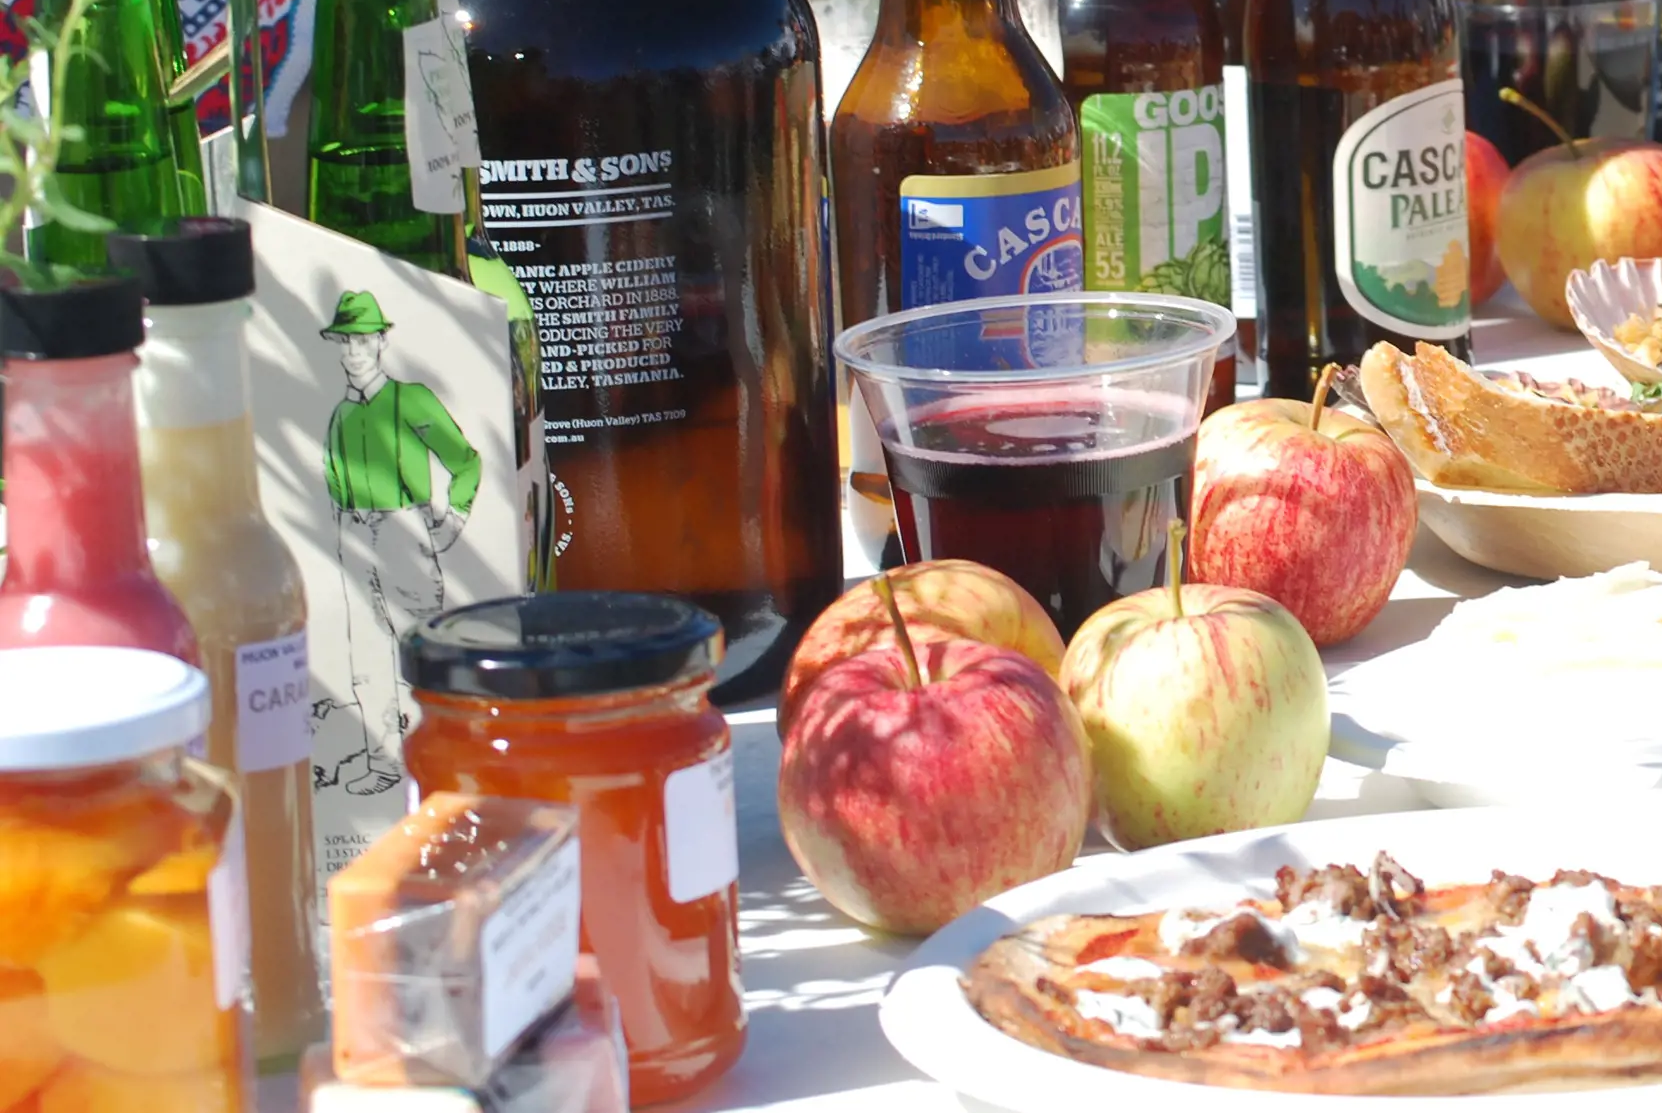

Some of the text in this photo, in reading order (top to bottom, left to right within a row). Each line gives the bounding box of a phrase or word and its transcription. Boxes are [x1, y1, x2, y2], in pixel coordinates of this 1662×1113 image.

[481, 158, 569, 185] SMITH
[571, 157, 597, 184] &
[521, 203, 570, 218] HUON
[571, 198, 641, 216] VALLEY,
[640, 194, 677, 209] TAS.
[1136, 122, 1225, 278] IP
[1390, 188, 1456, 229] PALE
[1095, 233, 1125, 248] ALE
[558, 261, 613, 277] APPLE
[615, 255, 676, 272] CIDERY
[1095, 250, 1126, 280] 55
[538, 278, 598, 295] WHERE
[600, 271, 677, 289] WILLIAM
[545, 292, 624, 310] ORCHARD
[625, 290, 643, 304] IN
[644, 287, 680, 303] 1888.
[561, 308, 617, 326] SMITH
[618, 303, 680, 321] FAMILY
[540, 318, 684, 343] ODUCING THE VERY
[641, 336, 673, 351] FOR
[564, 359, 579, 373] &
[579, 352, 671, 373] PRODUCED
[591, 367, 685, 388] TASMANIA.
[571, 417, 604, 430] (Huon
[604, 414, 641, 428] Valley)
[641, 411, 663, 424] TAS
[663, 408, 687, 421] 7109
